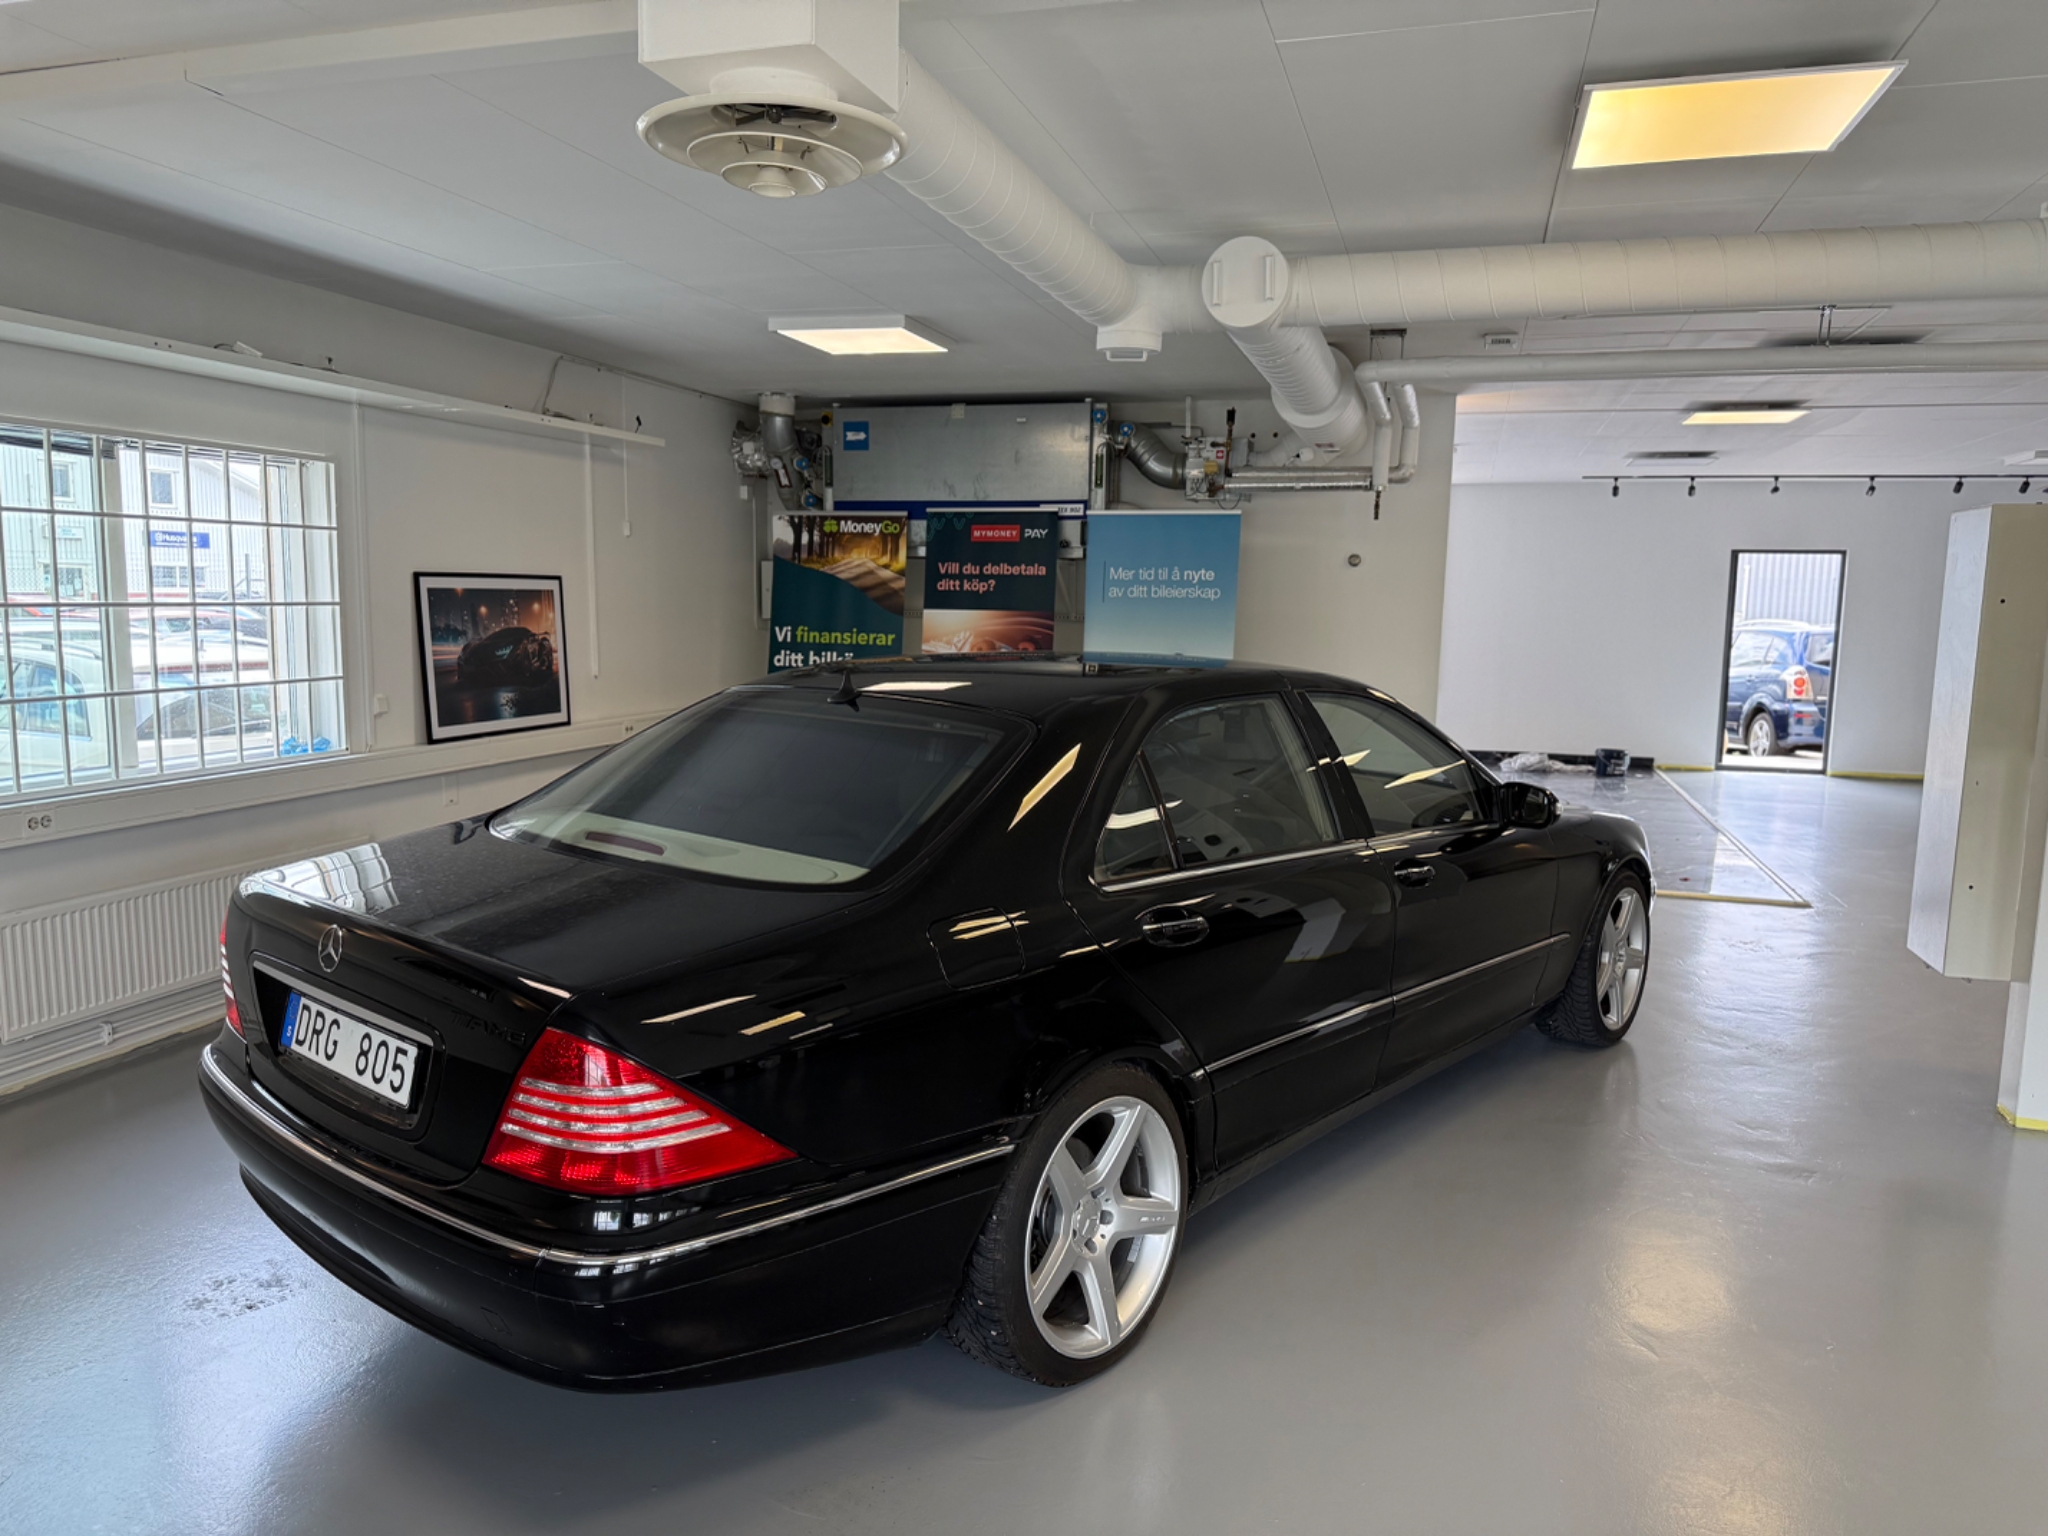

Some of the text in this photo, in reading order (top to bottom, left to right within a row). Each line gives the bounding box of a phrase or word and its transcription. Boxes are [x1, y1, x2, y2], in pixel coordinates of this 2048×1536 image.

[840, 520, 900, 536] MoneyGo
[973, 528, 1049, 539] MYMONEY PAY
[938, 562, 1047, 576] Vill du delbetala
[1109, 566, 1216, 584] Mer tid til å nyte
[936, 578, 996, 594] ditt köp?
[1108, 585, 1221, 601] av ditt bileierskap
[774, 626, 896, 646] Vi finansierar
[773, 650, 804, 668] ditt
[286, 1025, 293, 1038] S
[294, 1003, 409, 1094] DRG 805
